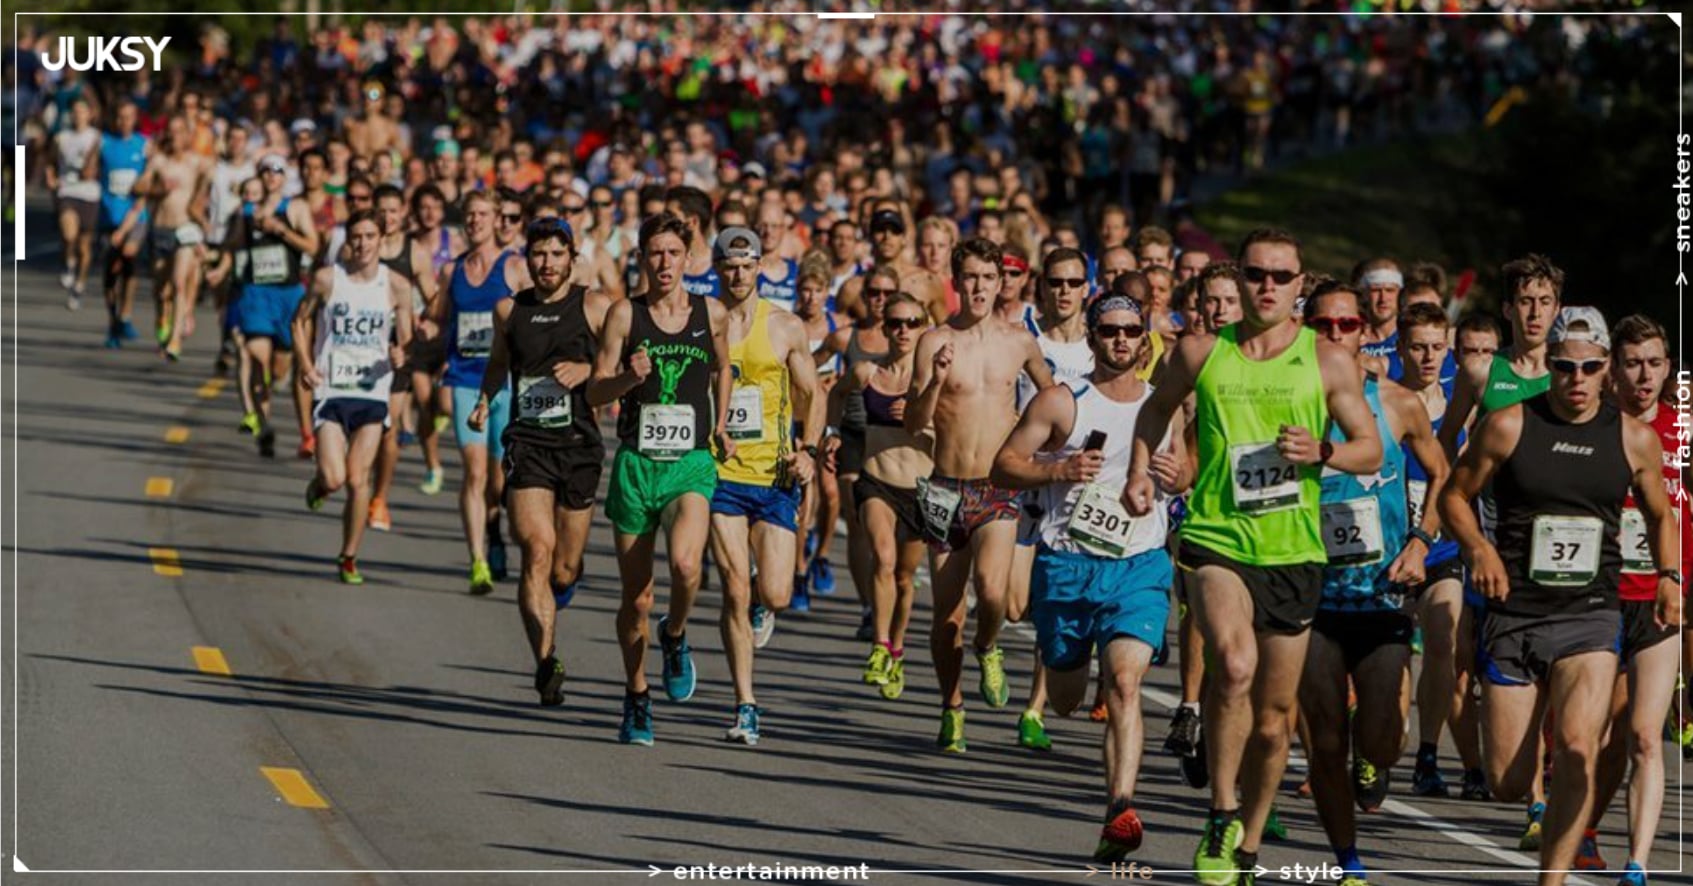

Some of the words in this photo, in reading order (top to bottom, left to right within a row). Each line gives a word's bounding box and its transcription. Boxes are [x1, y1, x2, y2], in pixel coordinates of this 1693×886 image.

[522, 395, 566, 410] 3984
[643, 425, 692, 441] 3970
[1238, 464, 1297, 489] 2124
[1078, 503, 1131, 536] 3301
[1334, 525, 1362, 546] 92
[1551, 543, 1581, 561] 37
